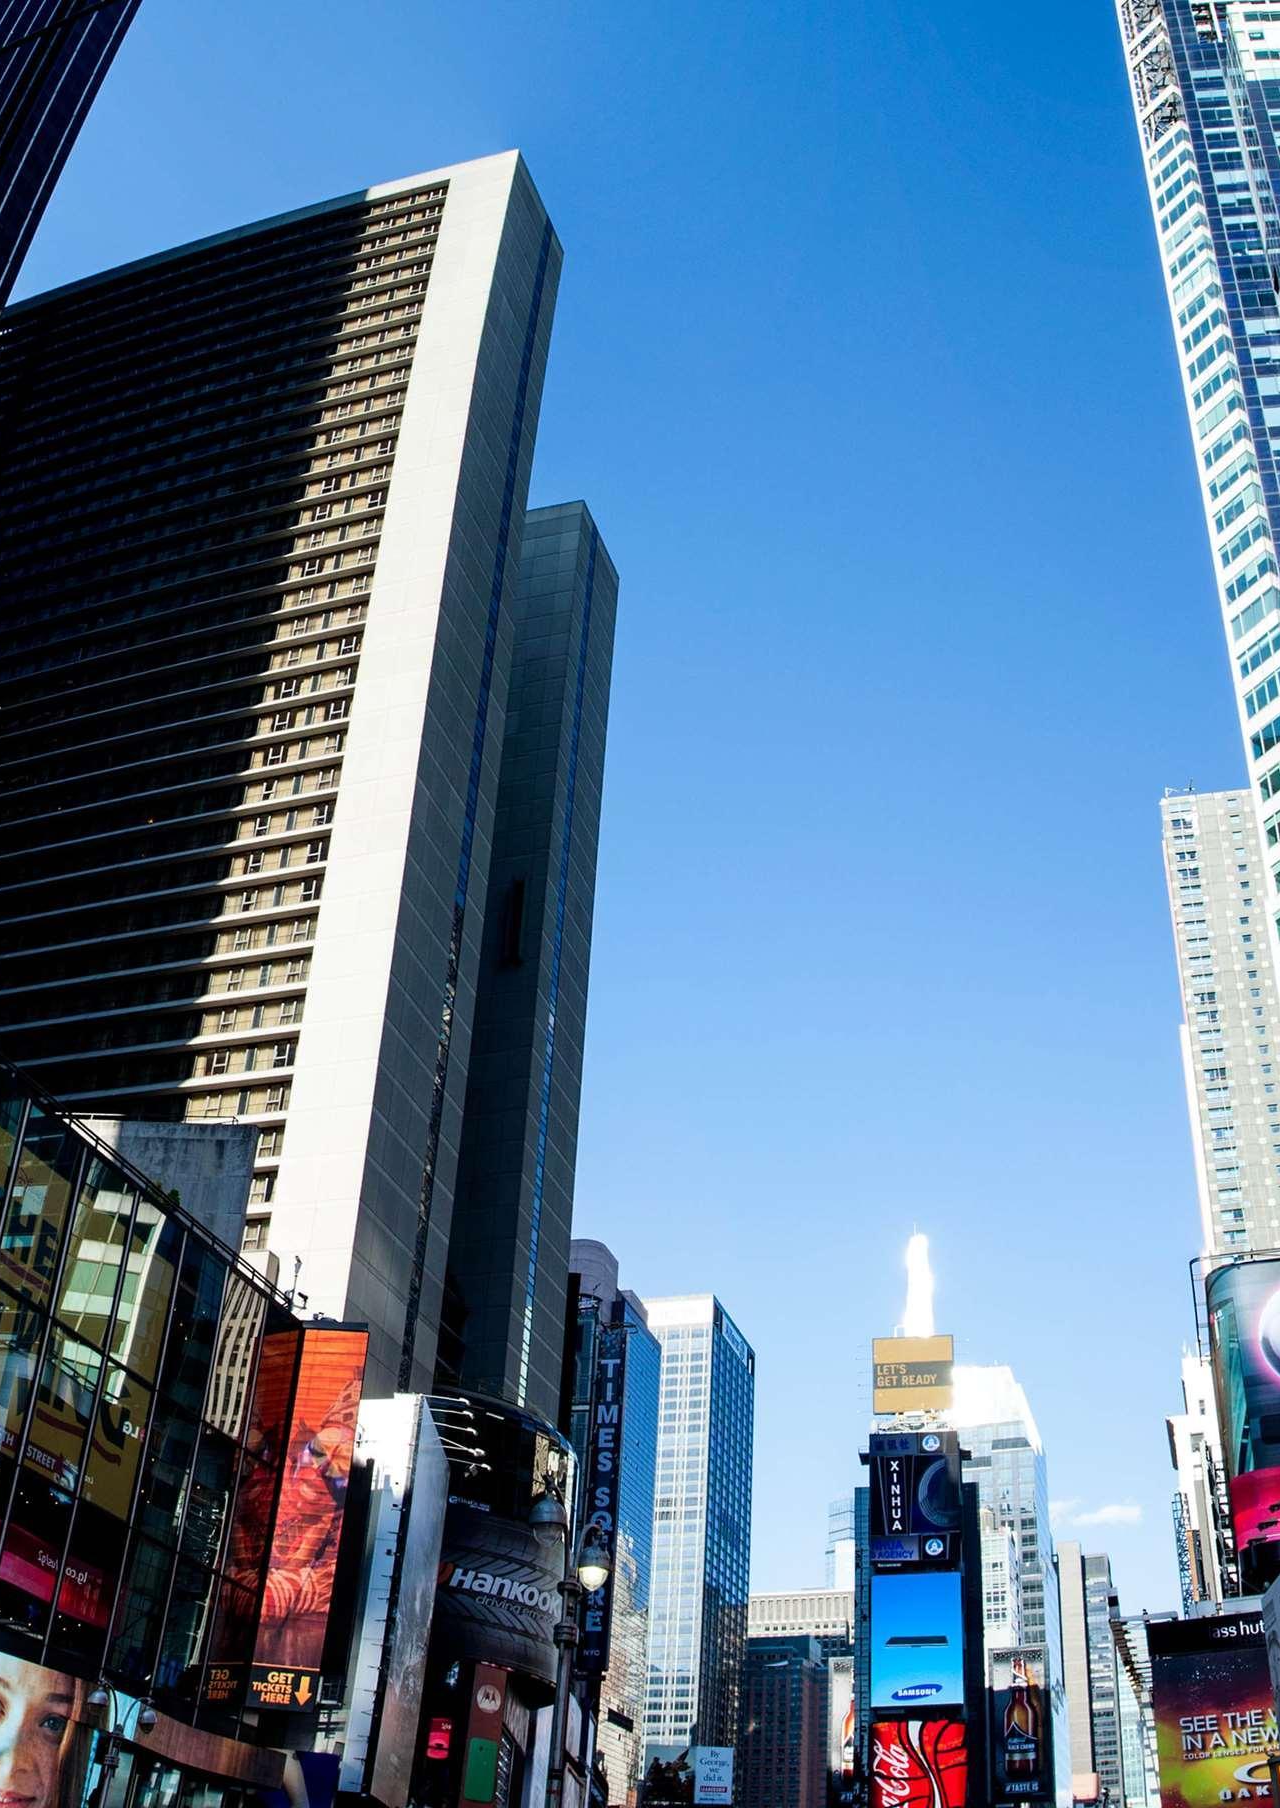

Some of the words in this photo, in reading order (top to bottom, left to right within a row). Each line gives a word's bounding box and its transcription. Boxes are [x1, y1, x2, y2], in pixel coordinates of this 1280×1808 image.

[877, 1363, 907, 1376] LET'S
[877, 1375, 898, 1387] GET
[901, 1373, 938, 1386] READY
[596, 1358, 621, 1473] TIMES
[24, 1443, 56, 1471] STREET
[889, 1459, 903, 1532] XINHUA
[584, 1486, 614, 1633] SQRE
[878, 1550, 915, 1560] AGENCY
[448, 1567, 563, 1620] Hankook
[1239, 1619, 1265, 1636] hut
[267, 1671, 295, 1685] GET
[252, 1681, 293, 1693] TICKETS
[897, 1687, 937, 1698] SAMSUNG
[259, 1691, 292, 1705] HERE
[1179, 1713, 1218, 1734] SEE
[1223, 1708, 1264, 1730] THE
[1182, 1732, 1203, 1751] IN
[1209, 1733, 1226, 1750] A
[1231, 1726, 1279, 1748] NEW
